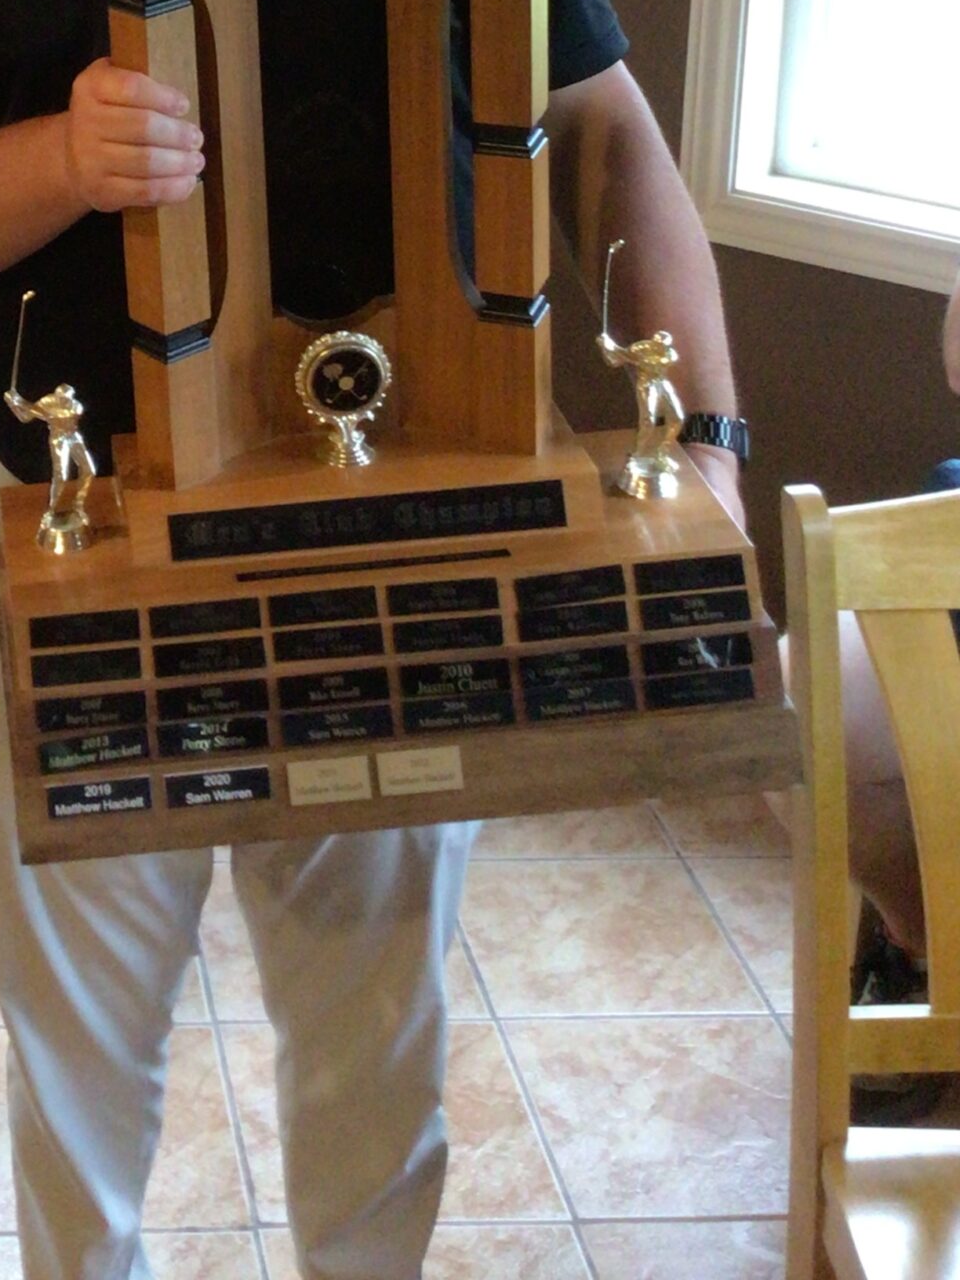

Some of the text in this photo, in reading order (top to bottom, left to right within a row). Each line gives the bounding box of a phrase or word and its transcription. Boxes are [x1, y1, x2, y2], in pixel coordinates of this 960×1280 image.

[439, 663, 474, 679] 2010
[200, 722, 229, 736] 2014
[202, 773, 232, 788] 2020
[83, 783, 113, 798] 2019
[185, 787, 253, 805] Sam Warren
[54, 795, 145, 817] Matthew Hackett
